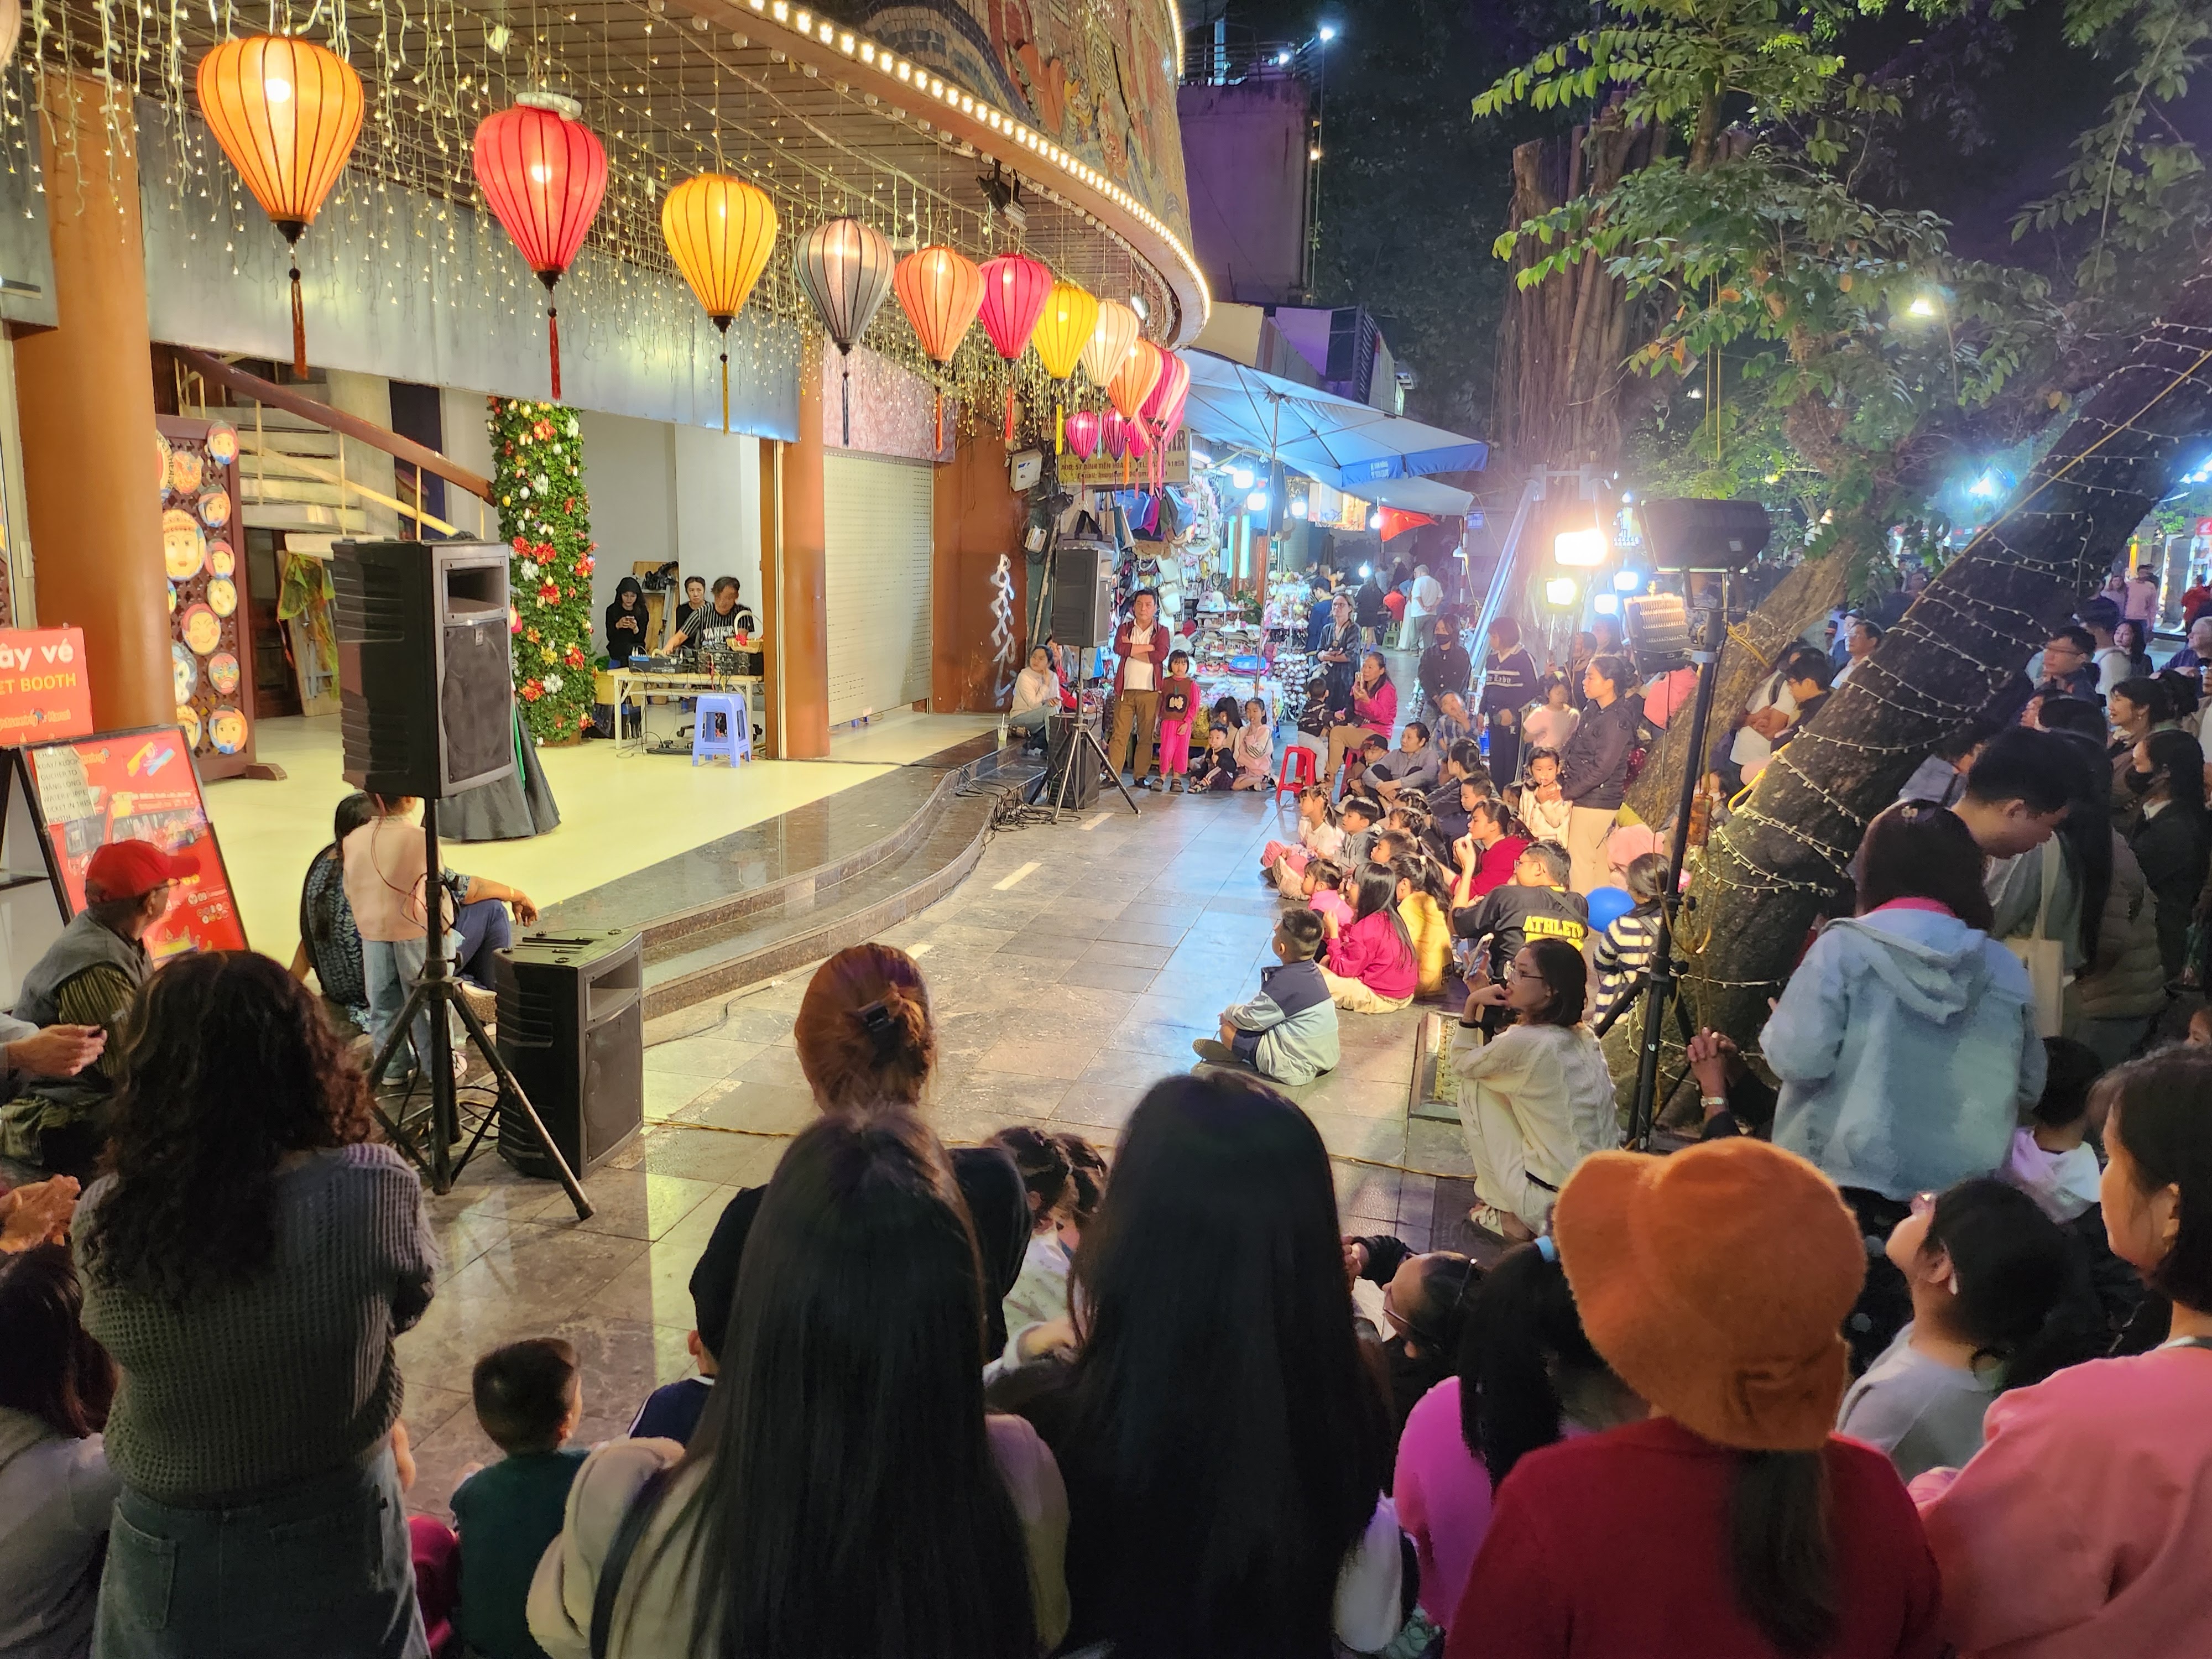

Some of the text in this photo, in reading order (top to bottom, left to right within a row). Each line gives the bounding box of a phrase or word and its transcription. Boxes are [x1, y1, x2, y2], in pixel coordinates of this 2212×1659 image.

[40, 638, 74, 664] vé
[20, 672, 76, 692] BOOTH
[39, 771, 66, 781] OUCHER
[64, 780, 81, 788] LONG
[44, 793, 65, 802] WATER
[46, 804, 66, 813] TICKET
[49, 815, 71, 824] BOOTH
